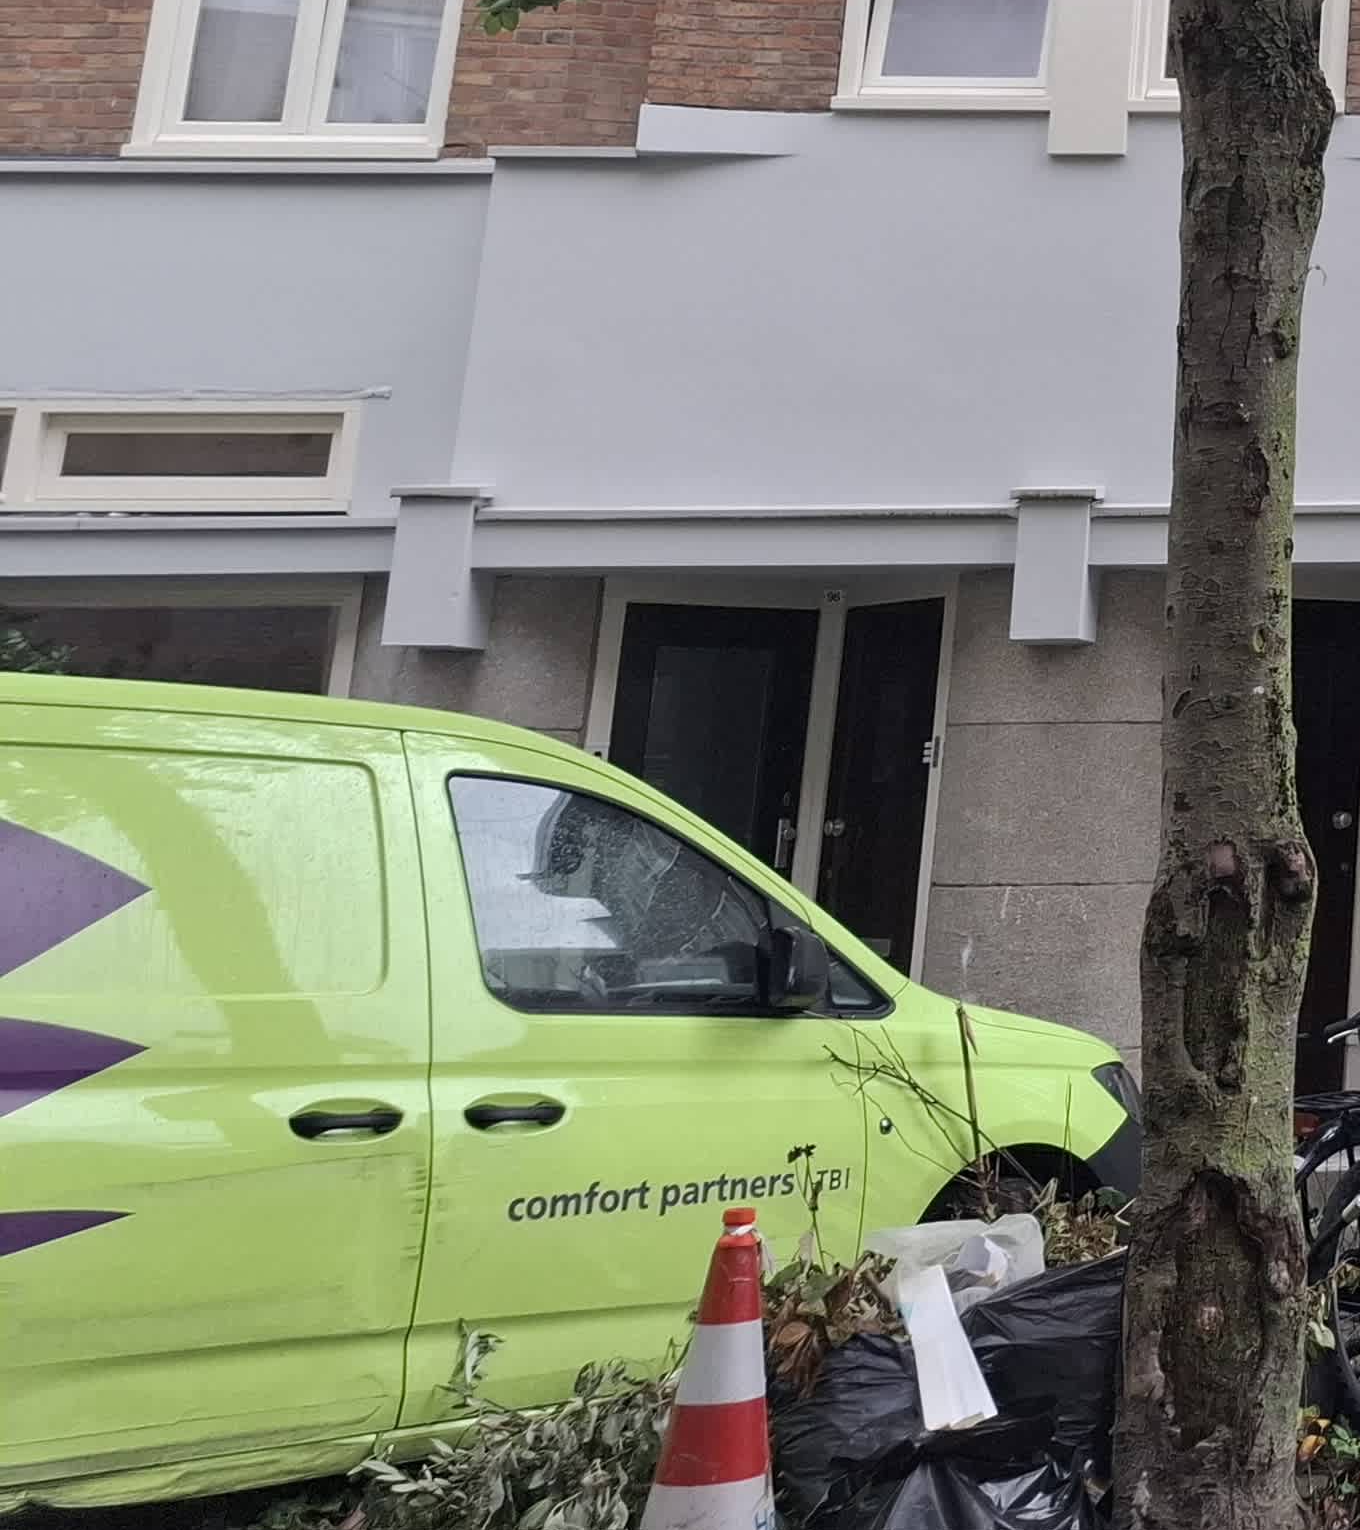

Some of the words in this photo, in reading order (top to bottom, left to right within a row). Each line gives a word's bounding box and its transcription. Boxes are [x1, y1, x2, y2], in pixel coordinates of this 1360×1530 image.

[507, 1181, 651, 1222] comfort
[659, 1173, 796, 1216] partners
[816, 1168, 850, 1192] TBI
